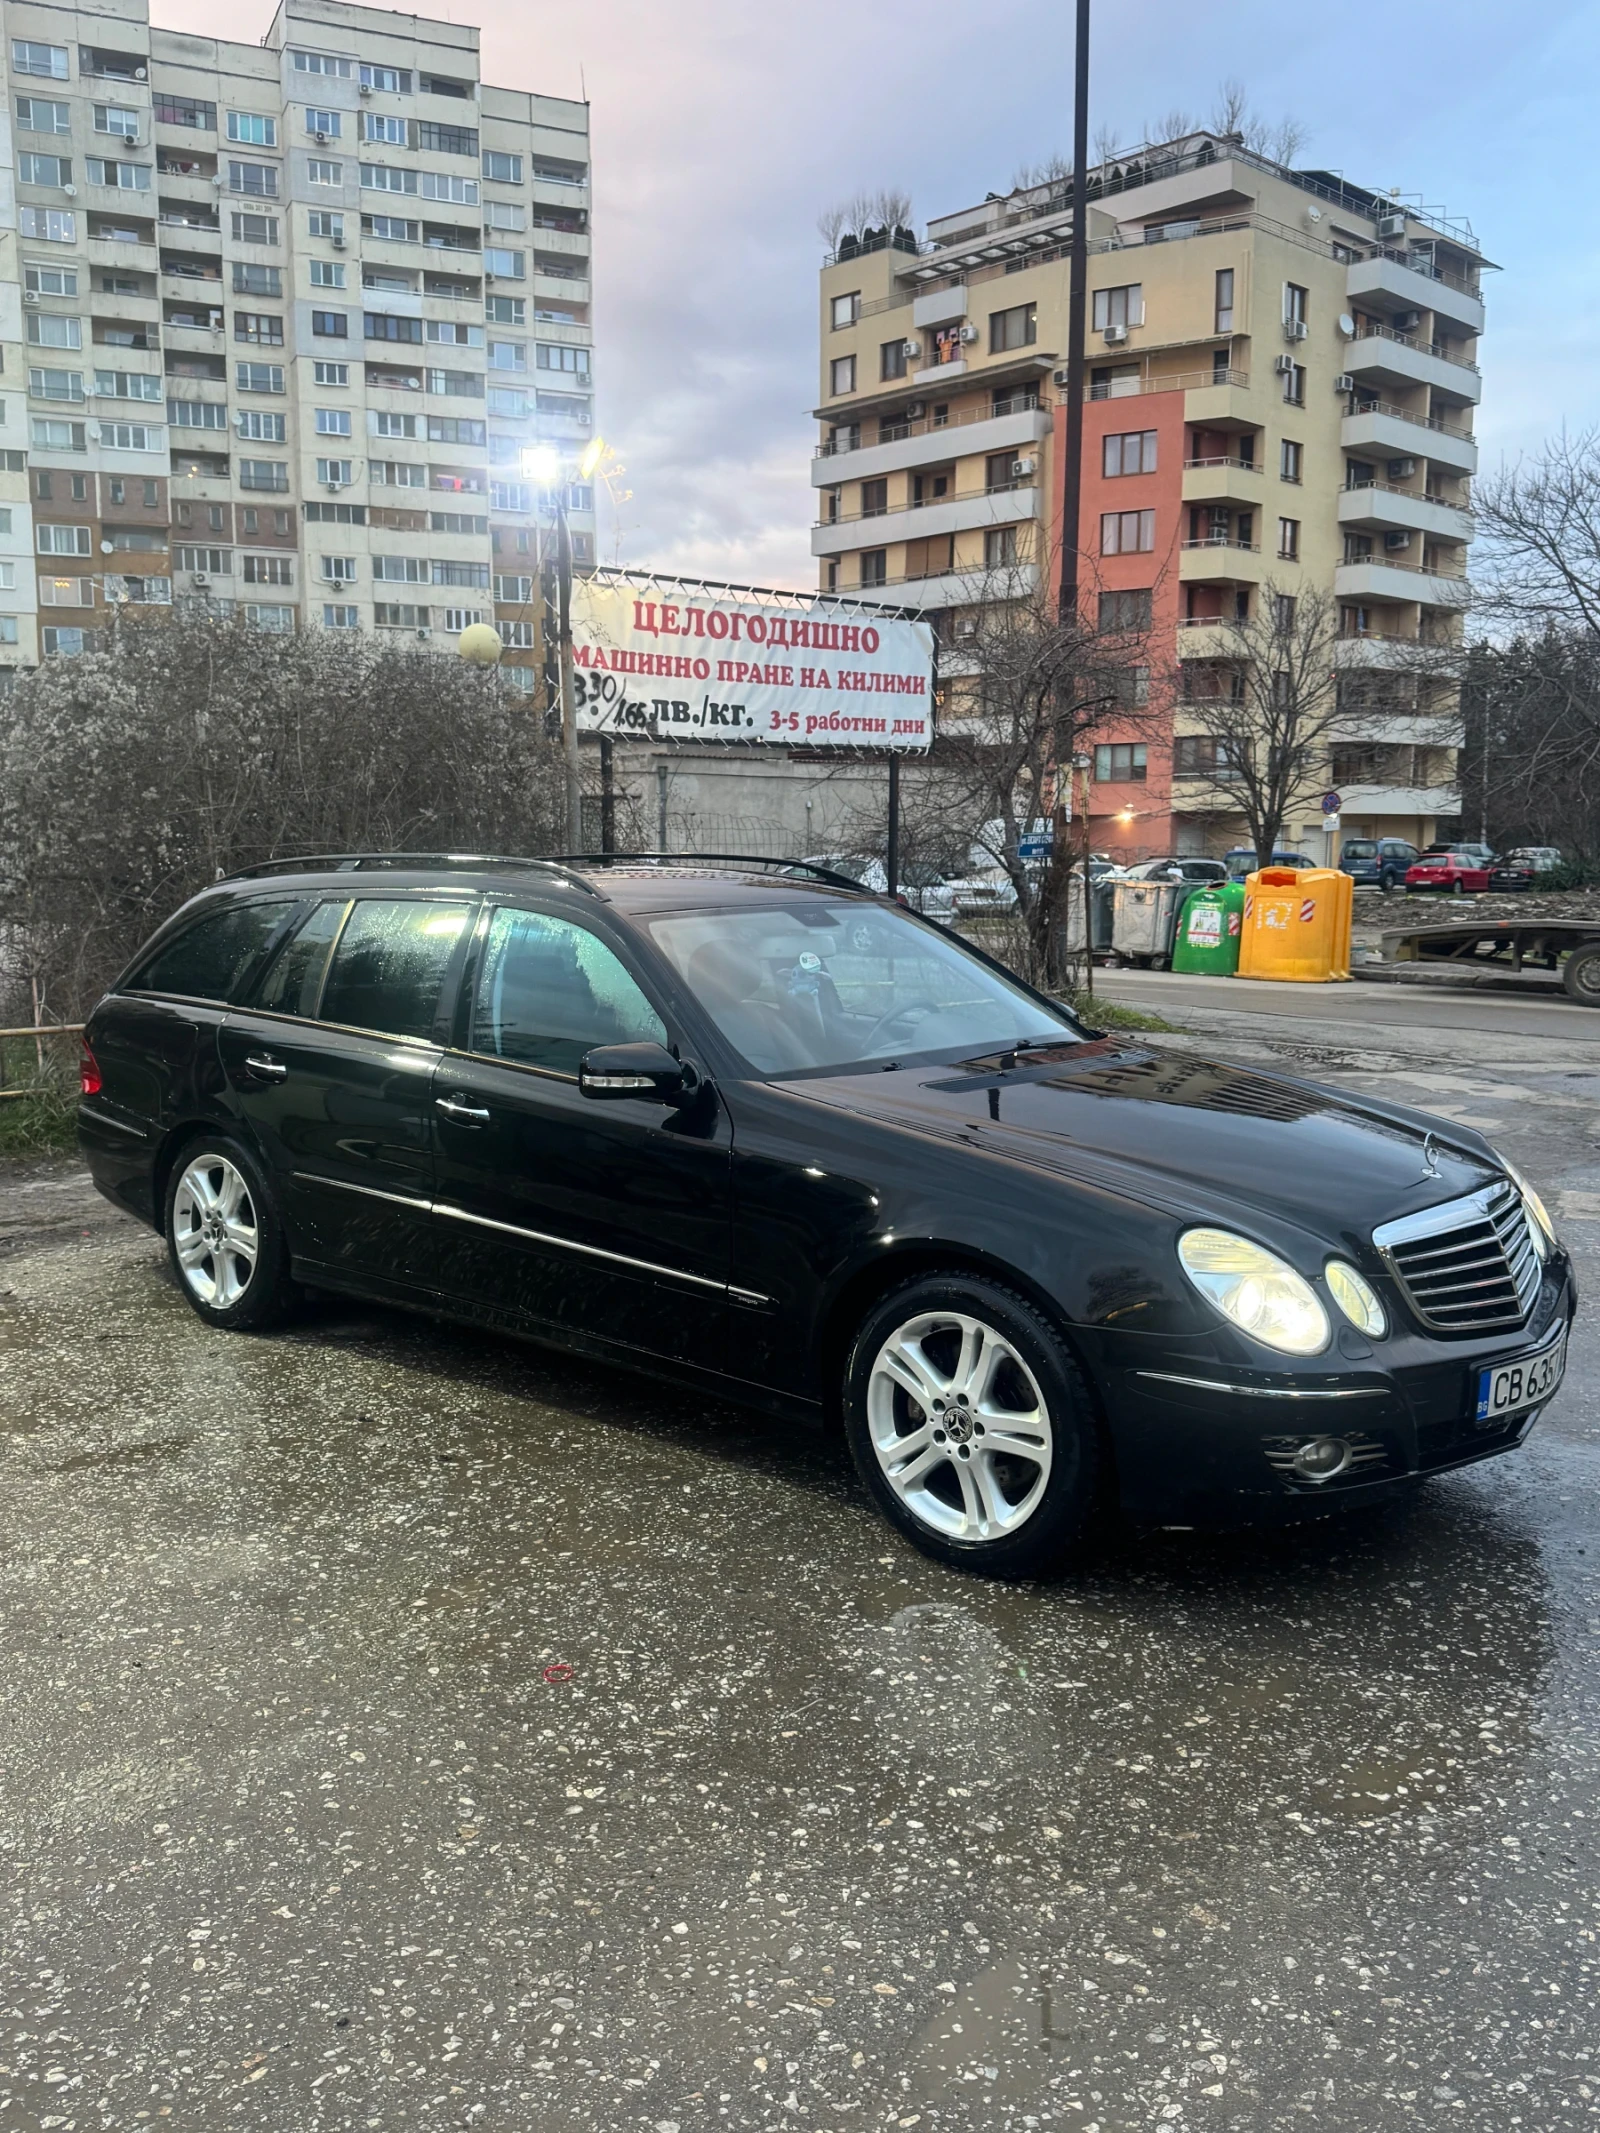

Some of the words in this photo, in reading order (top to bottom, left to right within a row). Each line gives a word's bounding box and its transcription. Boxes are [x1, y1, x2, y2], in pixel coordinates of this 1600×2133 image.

[633, 600, 880, 654] ЦЕЛОГОДИШНО
[572, 645, 710, 680] МАШИННО
[717, 660, 794, 686] ПРАНЕ
[800, 667, 831, 689] НА
[837, 670, 926, 695] КИЛИМИ
[769, 710, 799, 731] 3-5
[805, 710, 886, 734] работни
[891, 718, 925, 736] дни
[1477, 1401, 1488, 1412] BG
